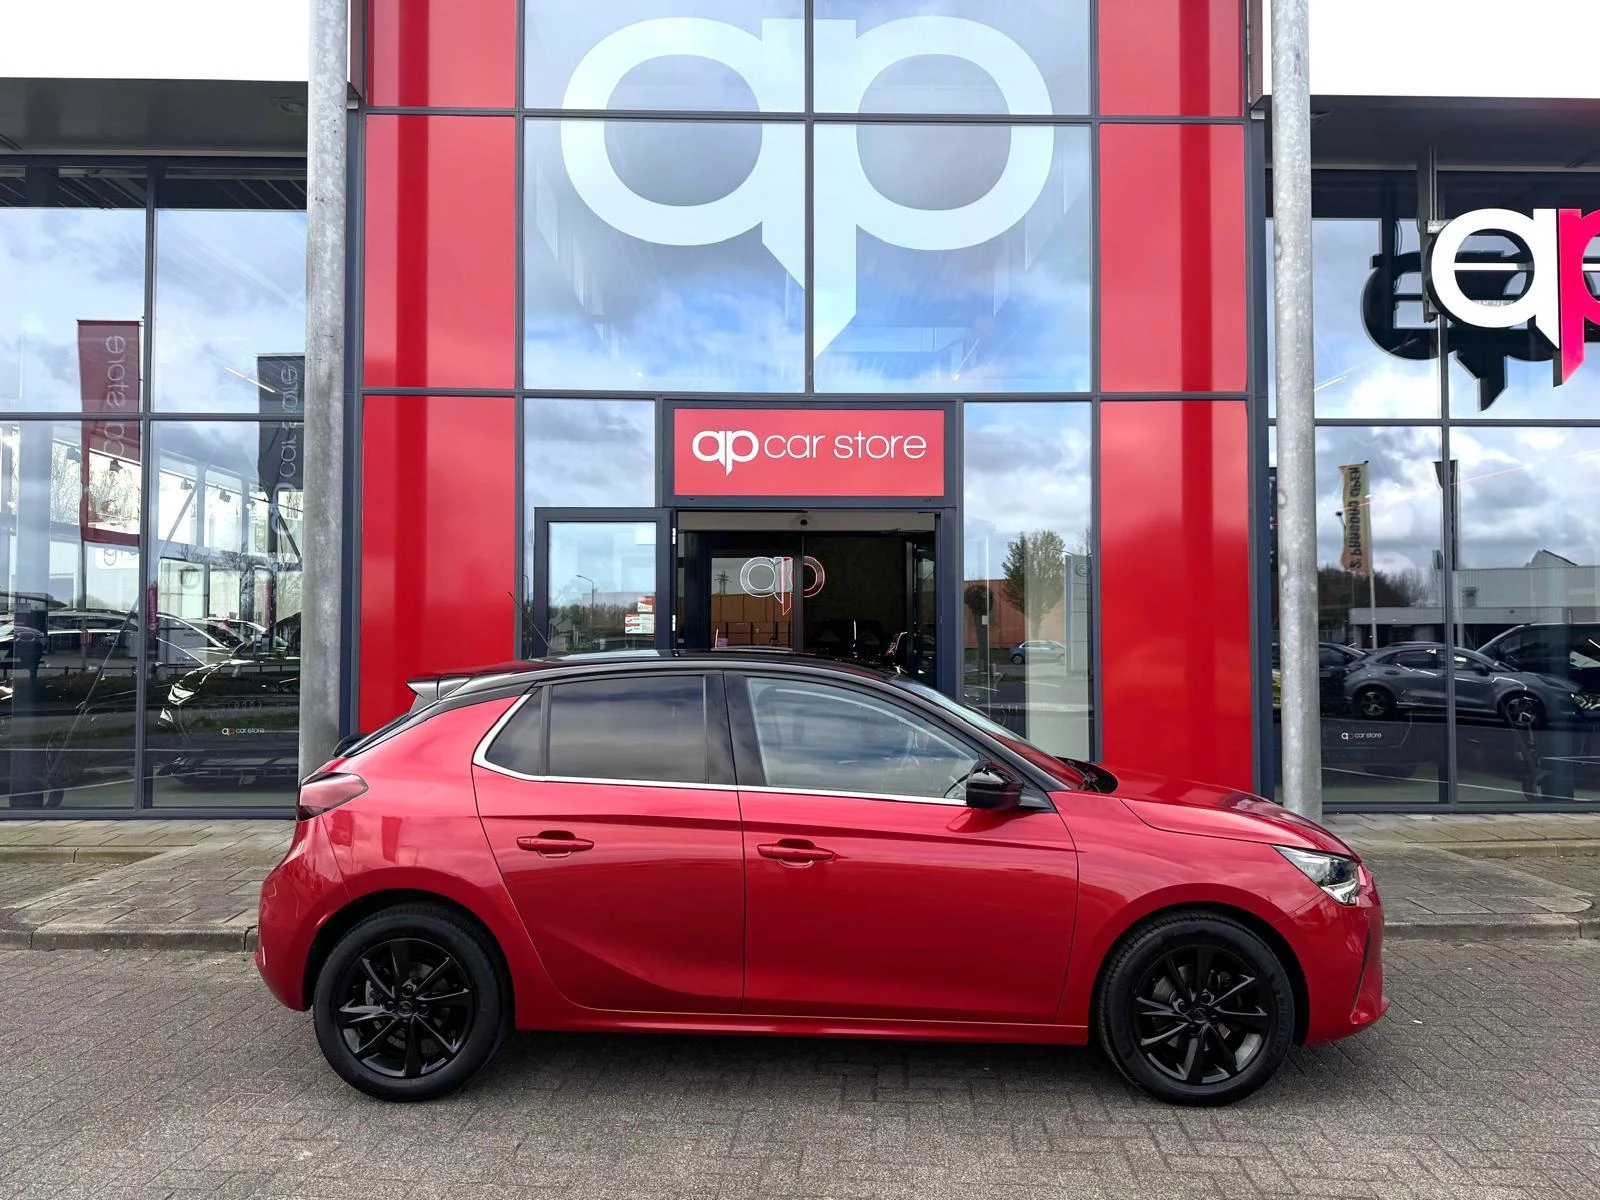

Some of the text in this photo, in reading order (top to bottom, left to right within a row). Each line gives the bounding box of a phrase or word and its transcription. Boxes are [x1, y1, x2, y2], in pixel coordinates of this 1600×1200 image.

[560, 16, 1054, 359] ap
[692, 430, 927, 476] ap car store
[740, 556, 826, 615] ap
